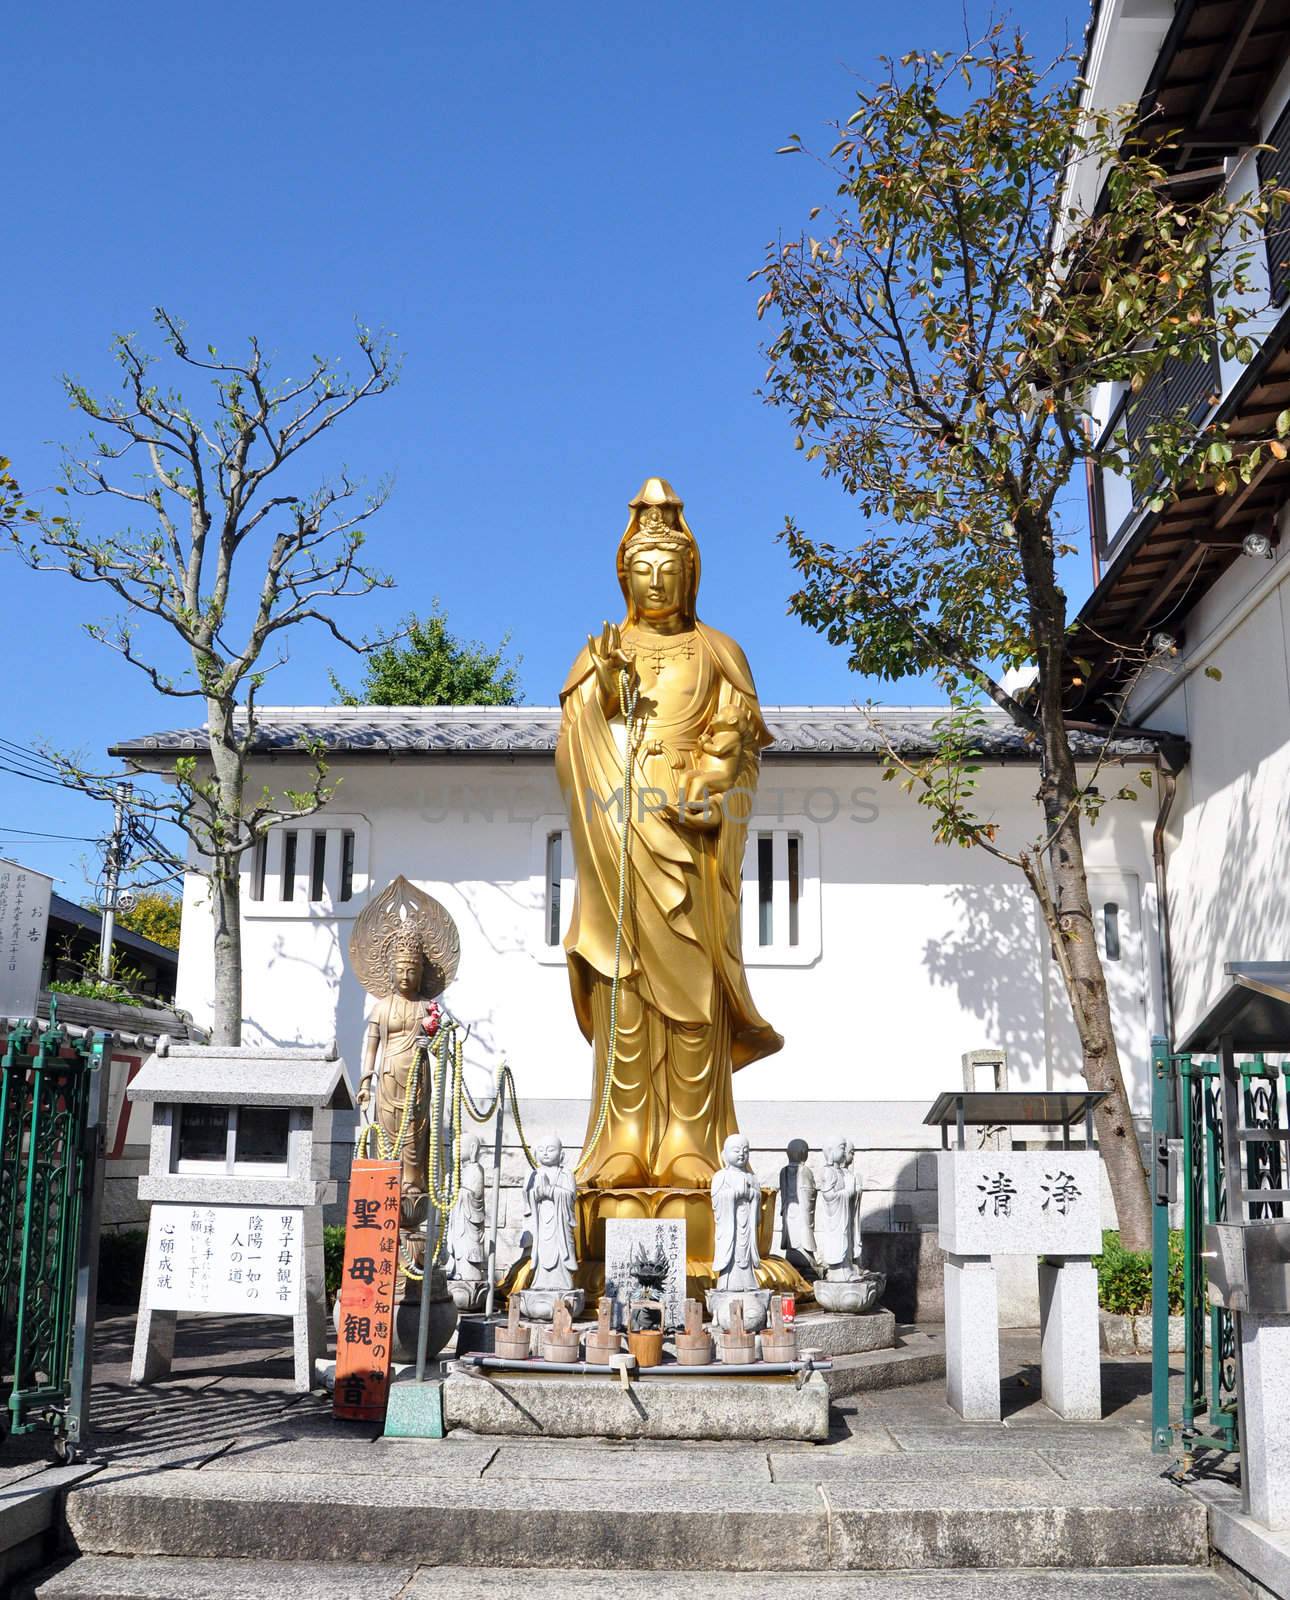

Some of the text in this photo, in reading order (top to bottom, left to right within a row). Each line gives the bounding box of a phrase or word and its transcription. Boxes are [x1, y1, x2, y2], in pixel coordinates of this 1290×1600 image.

[976, 1171, 1082, 1217] 清浄
[157, 1223, 176, 1289] 心願成就
[227, 1232, 244, 1284] 人の道
[246, 1215, 264, 1299] 陰陽一如の
[342, 1198, 382, 1405] 聖母観音
